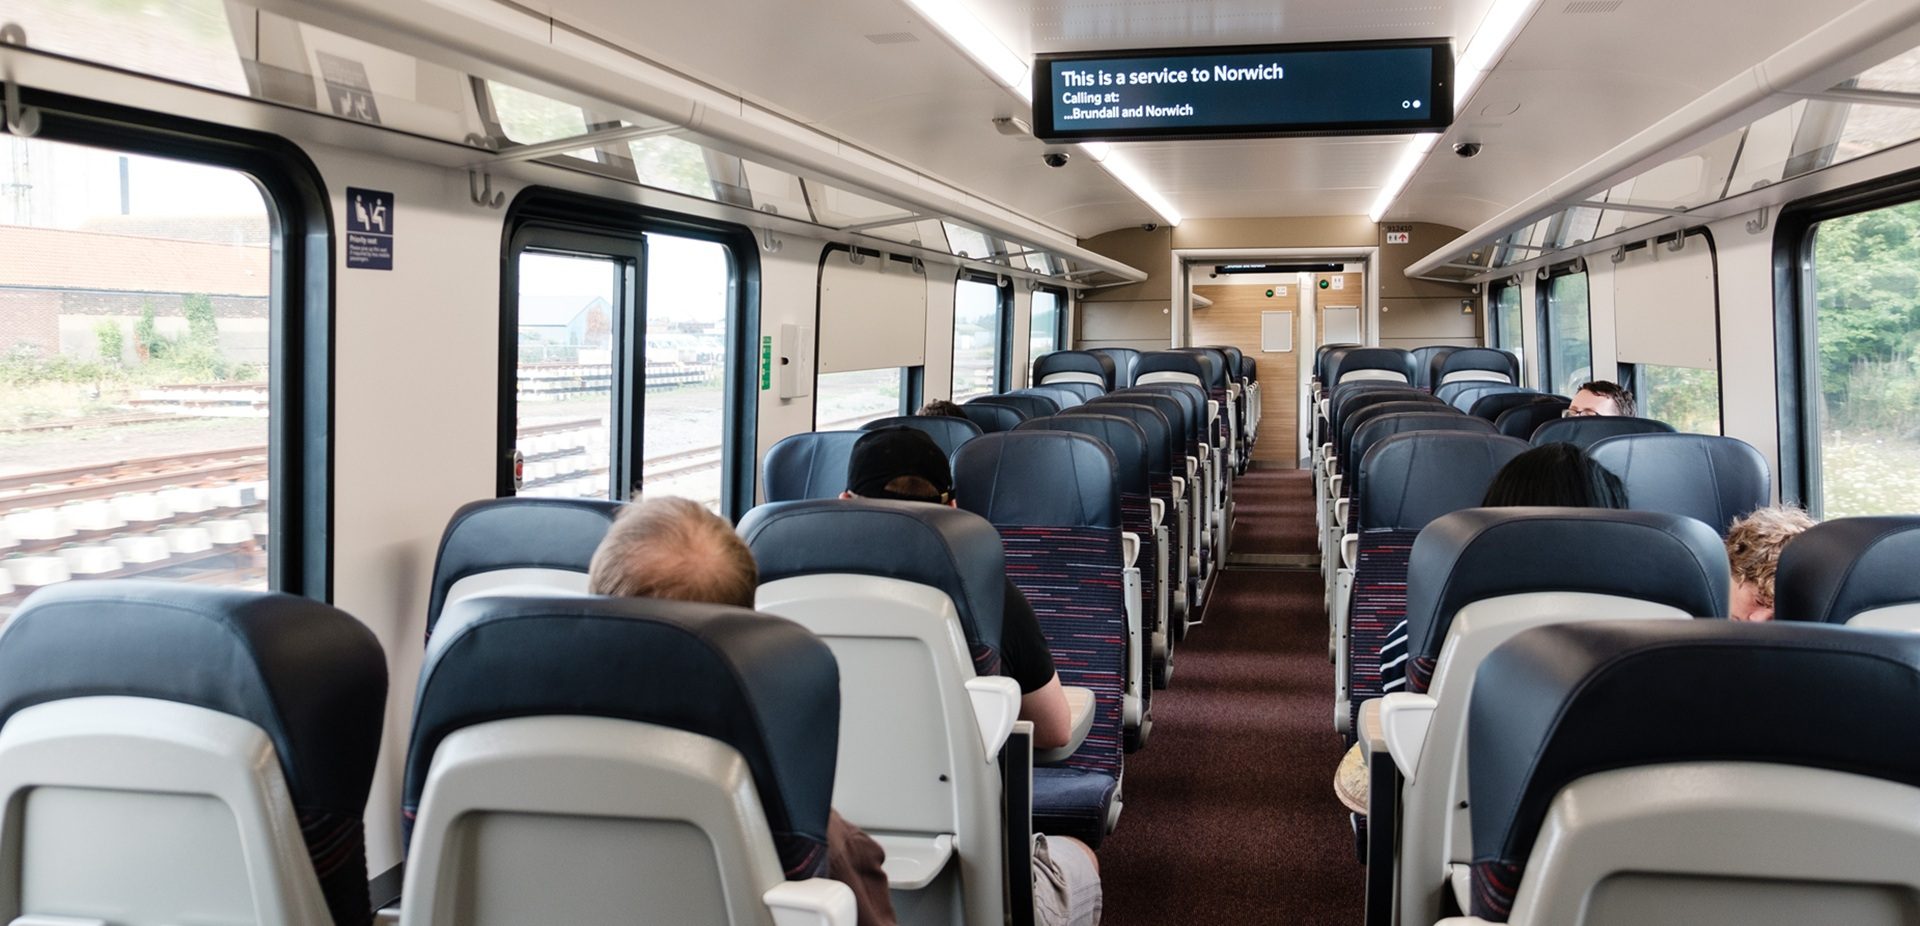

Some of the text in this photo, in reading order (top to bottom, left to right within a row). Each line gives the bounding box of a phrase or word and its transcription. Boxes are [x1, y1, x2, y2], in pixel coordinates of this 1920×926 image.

[1061, 63, 1284, 87] This is a service to Norwich
[1062, 91, 1120, 105] Calling at:
[1063, 104, 1194, 120] ...Brundall and Norwich
